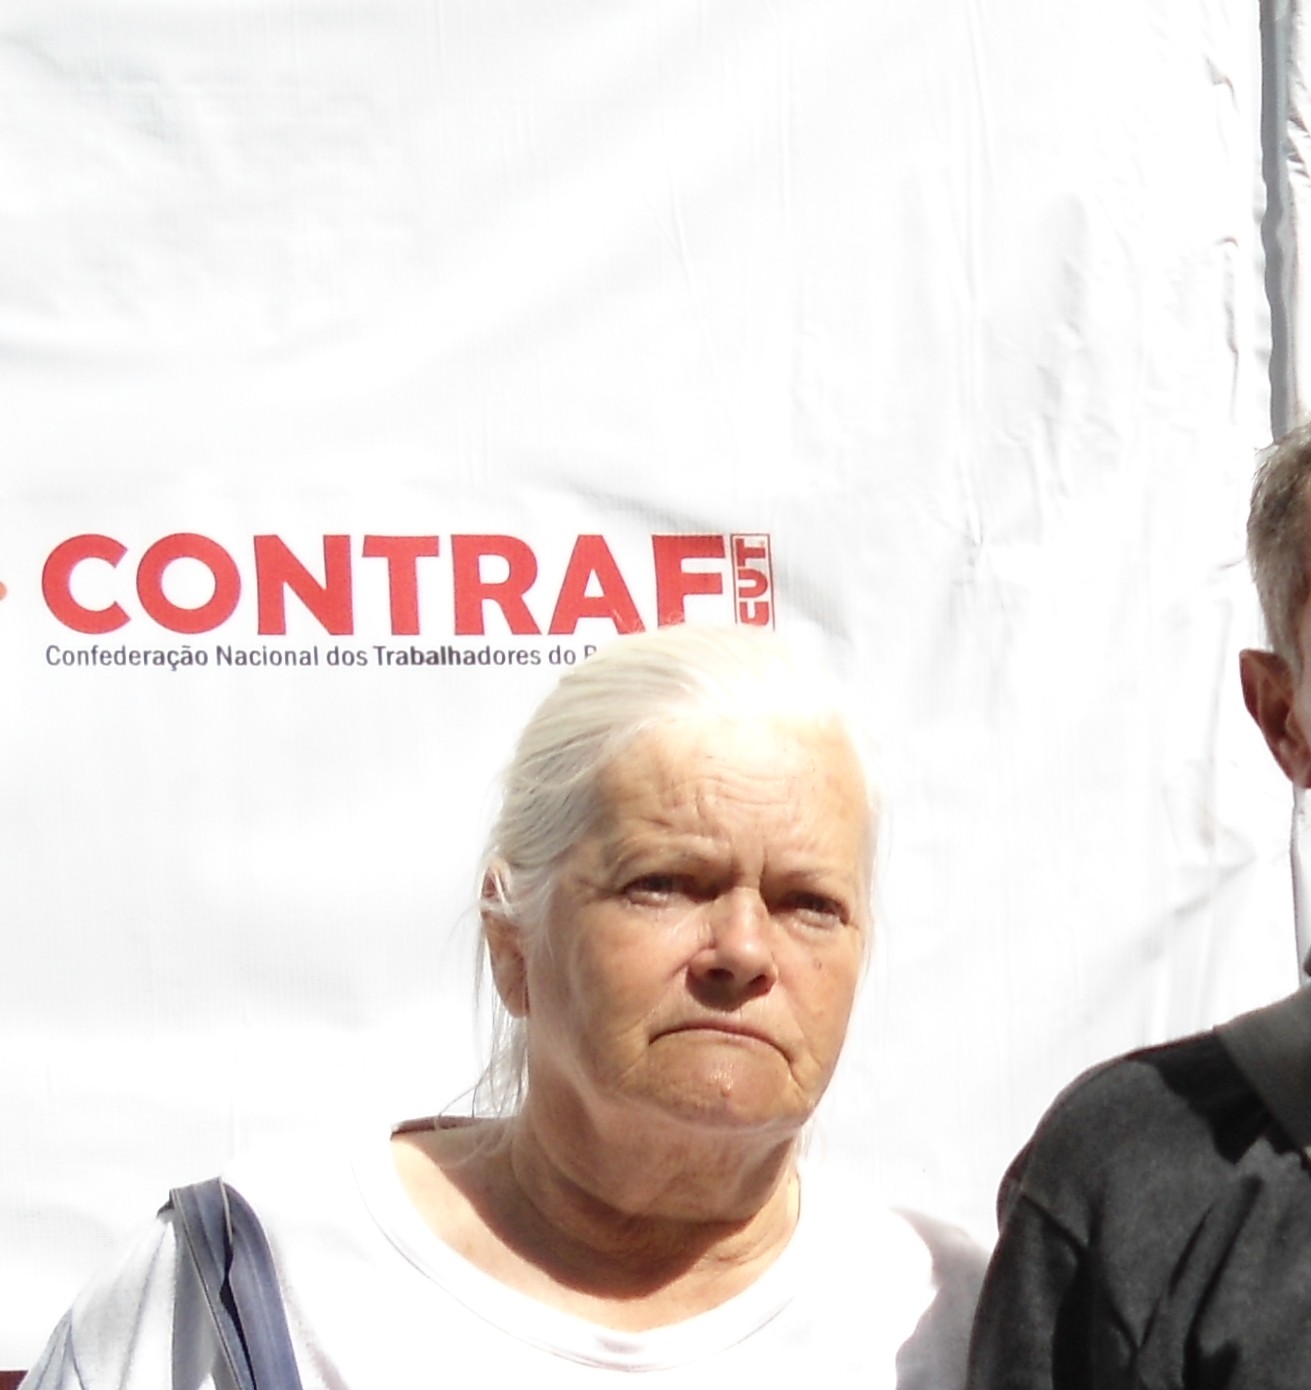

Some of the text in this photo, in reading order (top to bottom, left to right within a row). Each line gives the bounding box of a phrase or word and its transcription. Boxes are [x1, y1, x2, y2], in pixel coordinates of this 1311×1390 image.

[40, 532, 727, 636] CONTRAF
[734, 537, 770, 627] CUT
[45, 644, 209, 672] Confederação
[216, 645, 319, 667] Nacional
[326, 645, 368, 667] dos
[373, 645, 542, 667] Trabalhadores
[548, 645, 576, 666] do
